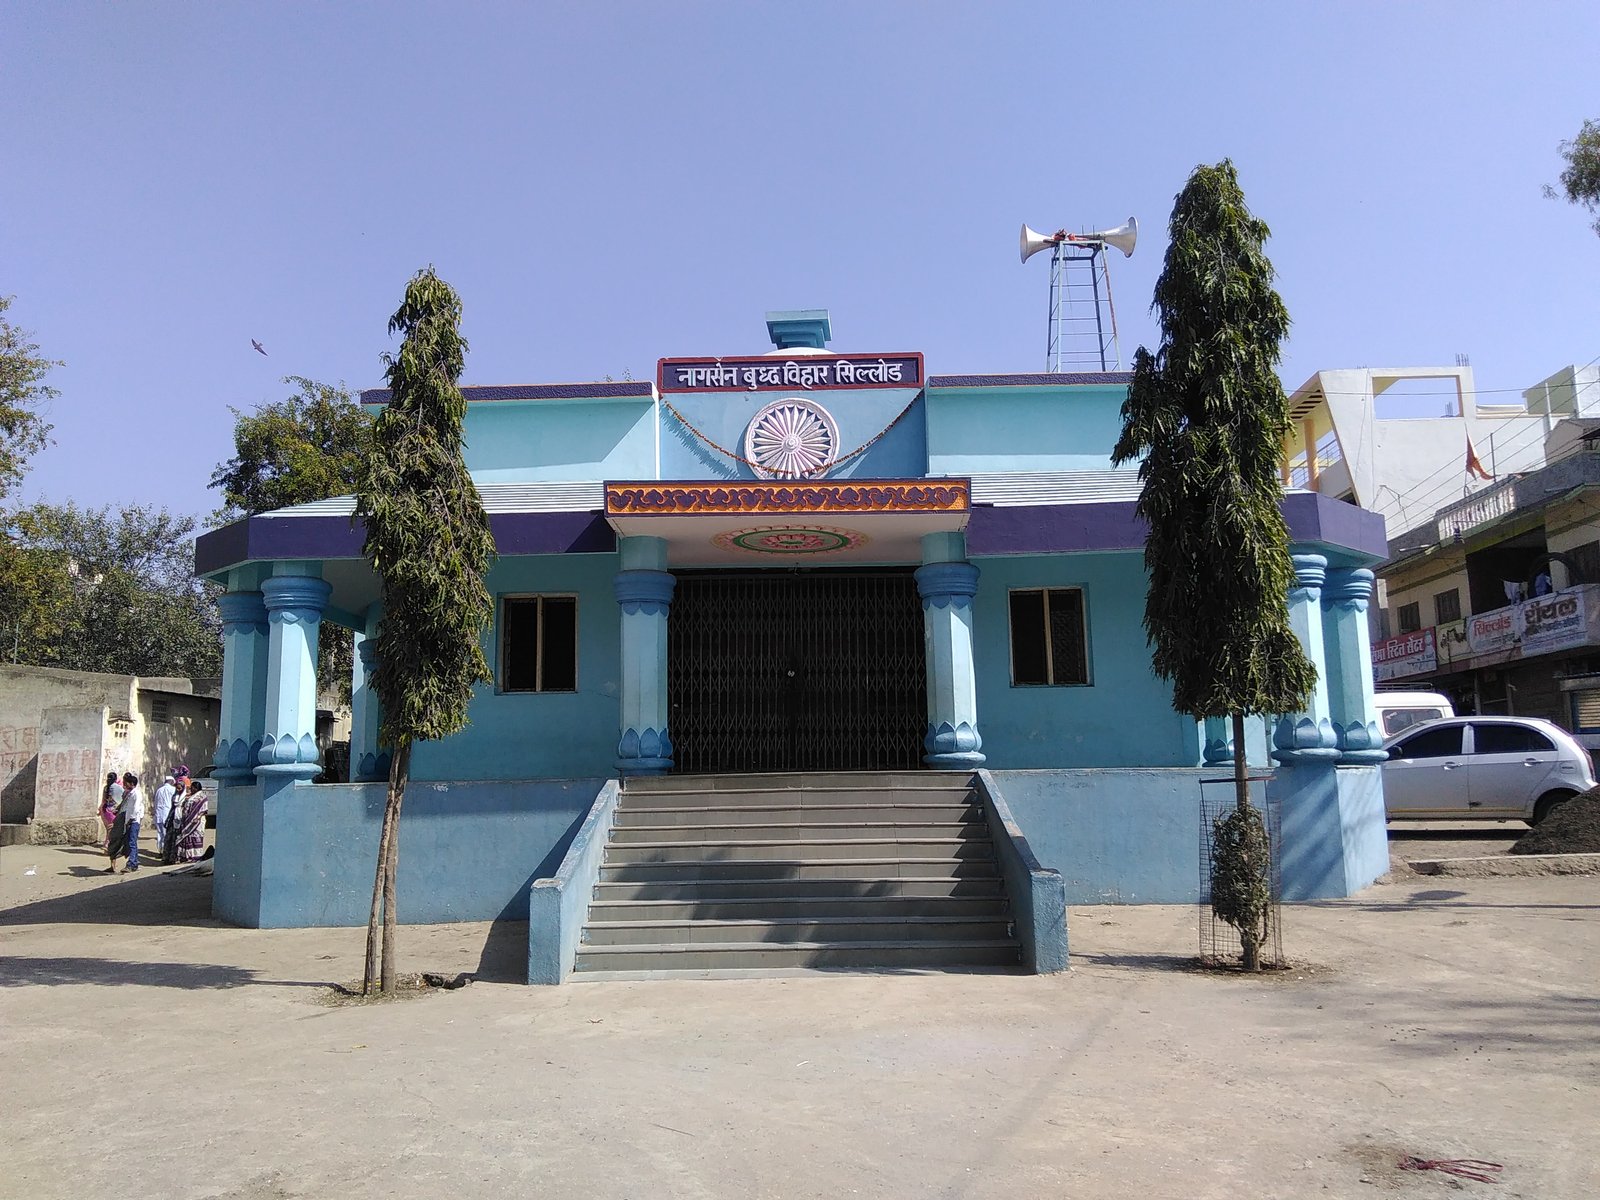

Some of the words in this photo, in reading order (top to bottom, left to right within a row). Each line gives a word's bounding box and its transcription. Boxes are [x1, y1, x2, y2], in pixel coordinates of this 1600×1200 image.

[677, 362, 738, 388] नागसेन
[782, 361, 829, 389] विहार
[835, 359, 903, 383] सिल्लोड
